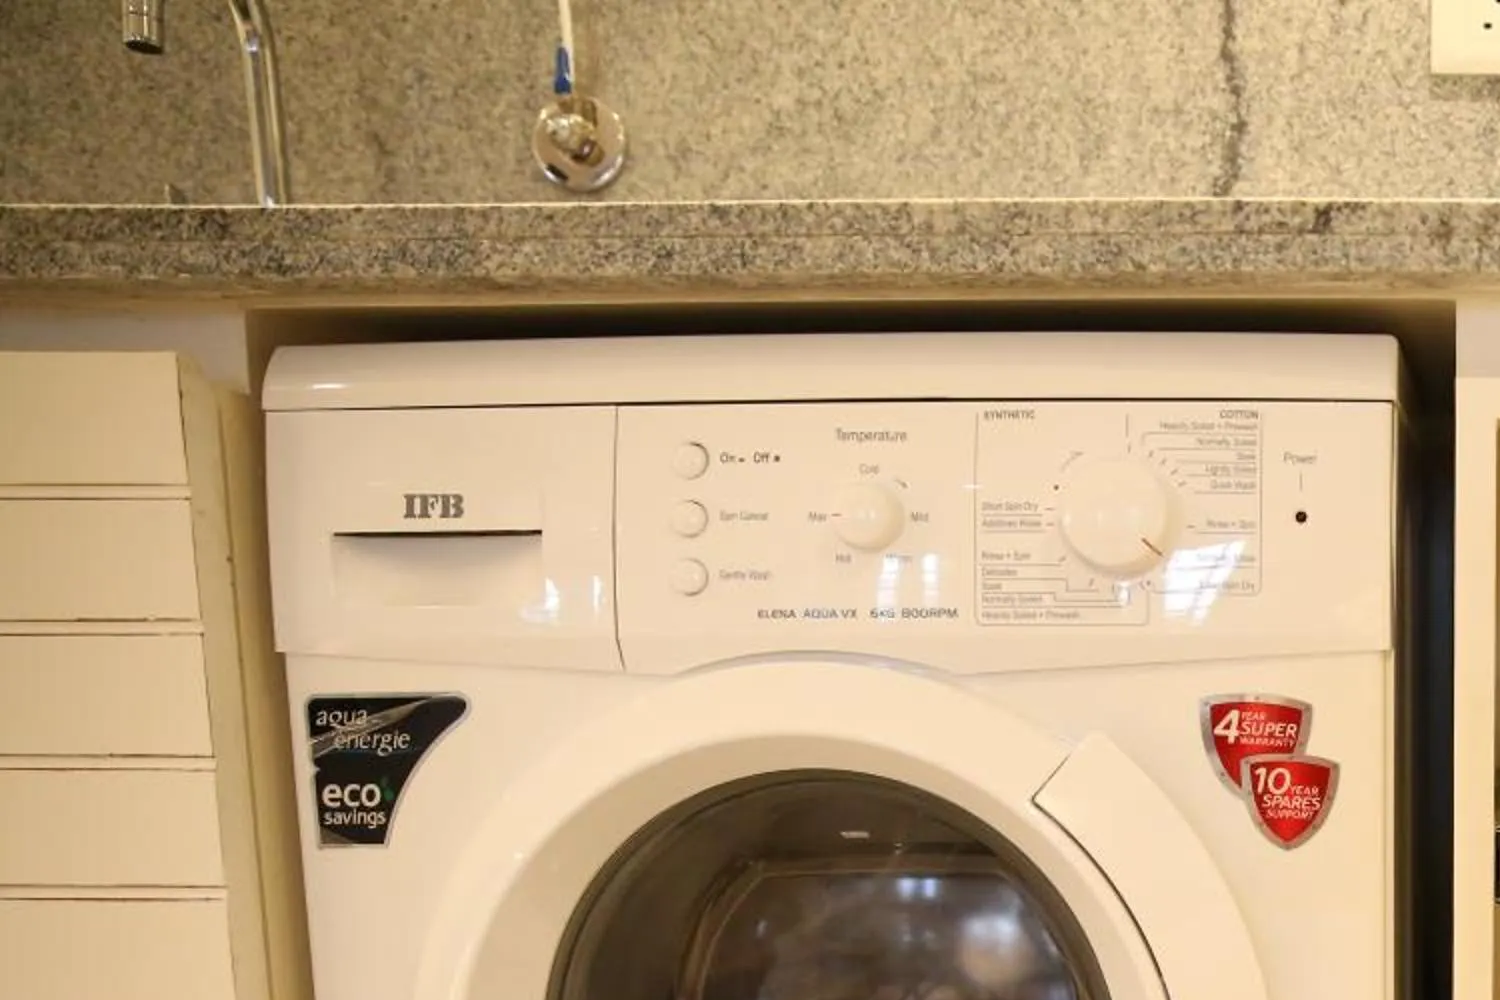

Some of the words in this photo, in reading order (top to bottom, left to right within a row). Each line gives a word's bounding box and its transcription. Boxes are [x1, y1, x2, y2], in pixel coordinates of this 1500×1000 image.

[1219, 408, 1259, 419] COTTON
[836, 427, 908, 443] Temperature
[719, 451, 736, 463] On
[753, 450, 771, 464] Off
[1283, 450, 1318, 464] Power
[858, 463, 881, 475] Cold
[403, 493, 464, 519] IFB
[757, 608, 797, 619] ELENA
[802, 608, 838, 619] AQUA
[841, 608, 858, 619] VX
[901, 608, 959, 619] 800RPM
[315, 708, 369, 730] aqua
[1241, 711, 1267, 720] YEAR
[1213, 709, 1241, 744] 4
[1239, 720, 1298, 738] SUPER
[334, 729, 411, 757] energie
[1239, 735, 1296, 748] WARRANTY
[1255, 767, 1292, 795] 10
[1289, 785, 1320, 796] YEAR
[321, 783, 382, 808] eco
[1261, 793, 1321, 811] SPARES
[323, 809, 387, 829] savings
[1265, 809, 1315, 821] SUPPORT
